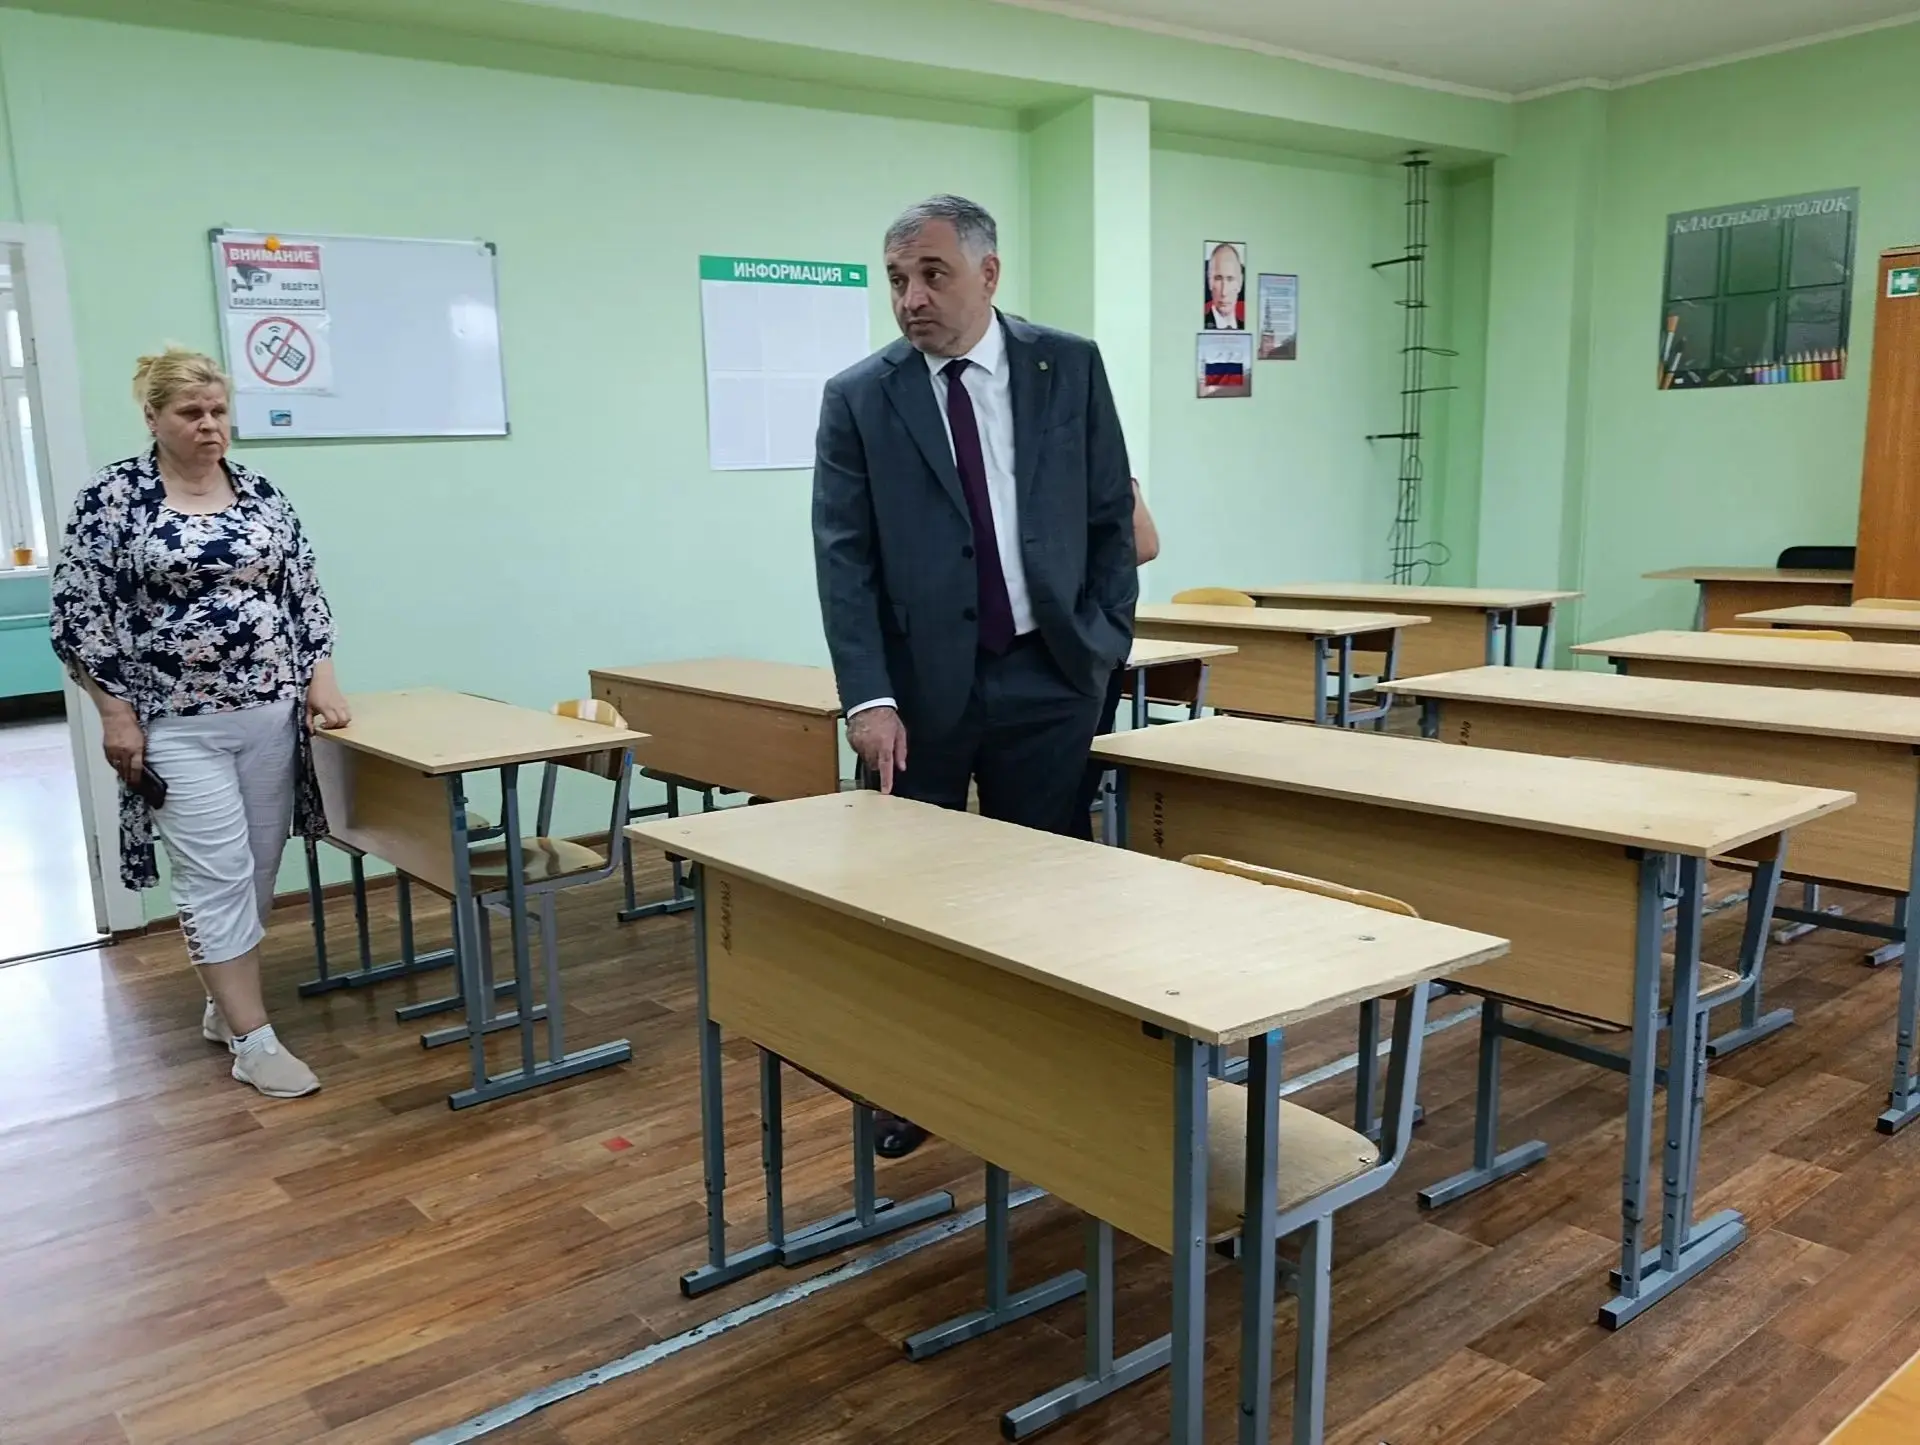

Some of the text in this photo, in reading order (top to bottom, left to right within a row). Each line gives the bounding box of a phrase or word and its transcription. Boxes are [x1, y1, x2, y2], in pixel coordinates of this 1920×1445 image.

[1674, 196, 1851, 234] КЛАССНЫЙ УГОЛОК
[229, 248, 314, 263] ВНИМАНИЕ
[733, 262, 842, 283] ИНФОРМАЦИЯ
[233, 298, 321, 307] ВИДЕОНАБЛЮДЕНИЕ
